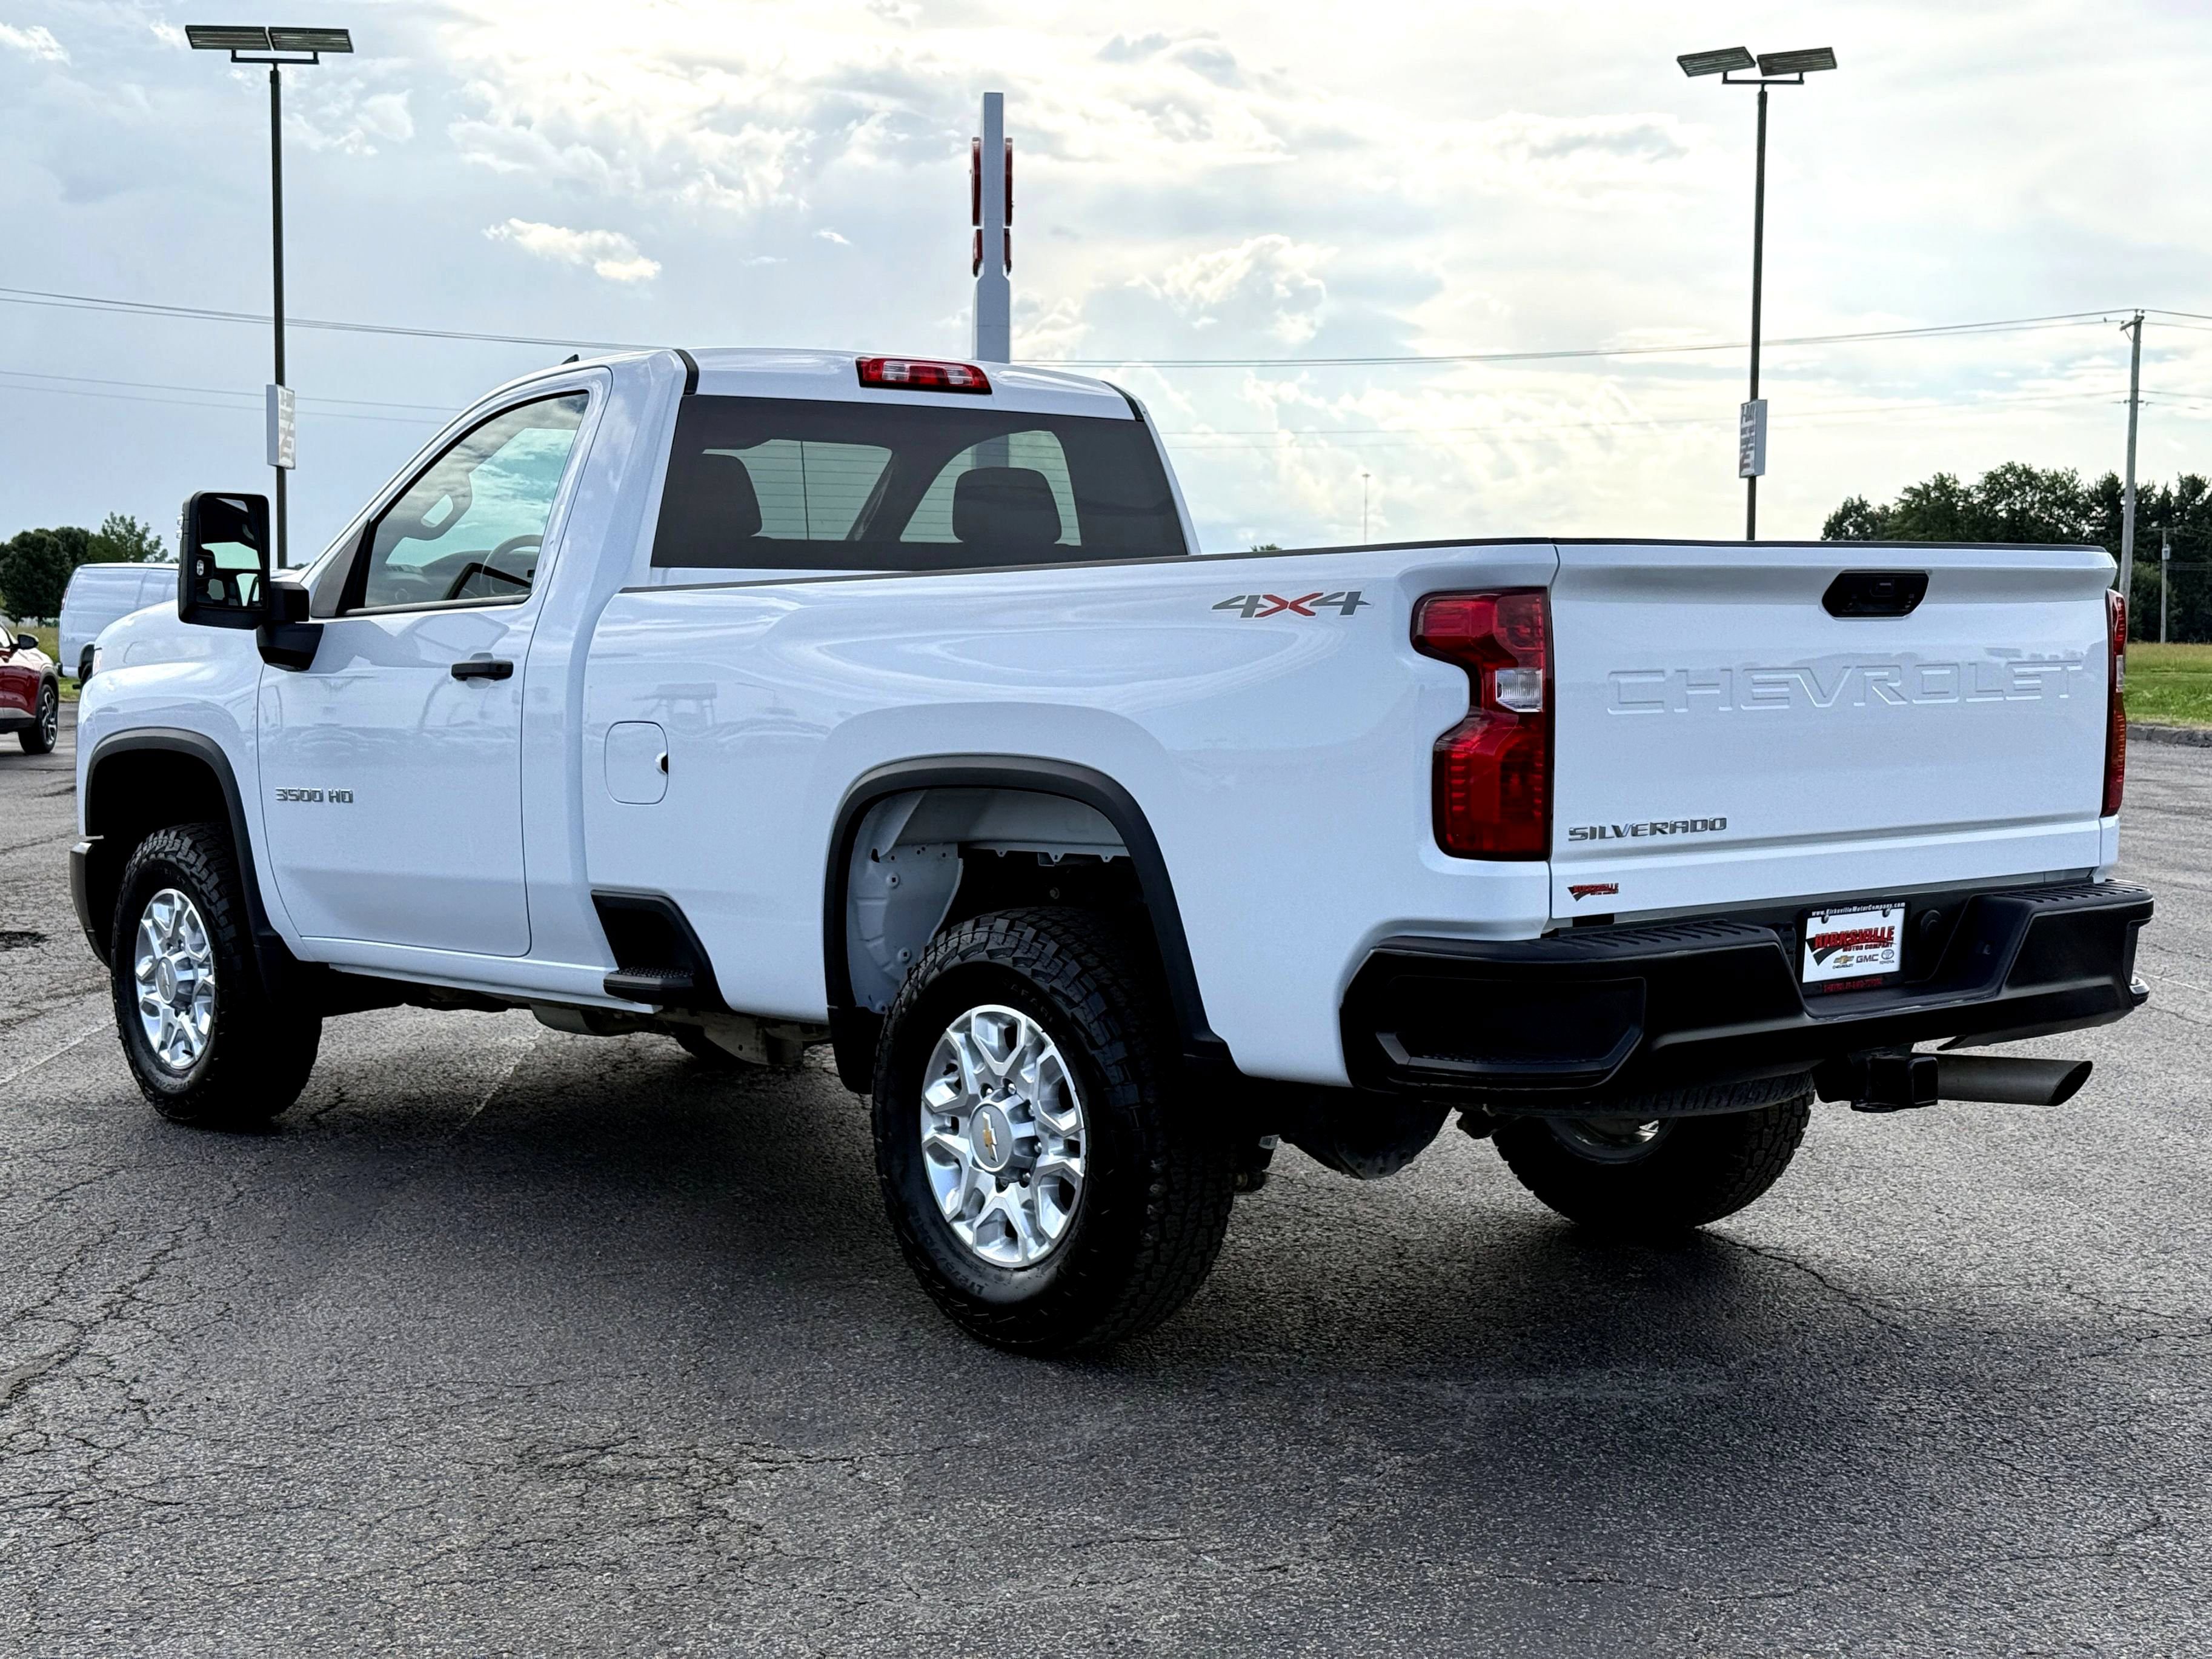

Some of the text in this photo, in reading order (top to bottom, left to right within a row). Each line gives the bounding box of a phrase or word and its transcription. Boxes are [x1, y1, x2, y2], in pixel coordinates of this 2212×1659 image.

[1607, 661, 2084, 715] CHEVROLET
[276, 787, 353, 803] 3500 HD
[1568, 817, 1727, 841] SILVERADO
[1813, 926, 1895, 949] KIRKSVILLE
[1856, 954, 1879, 963] GMC
